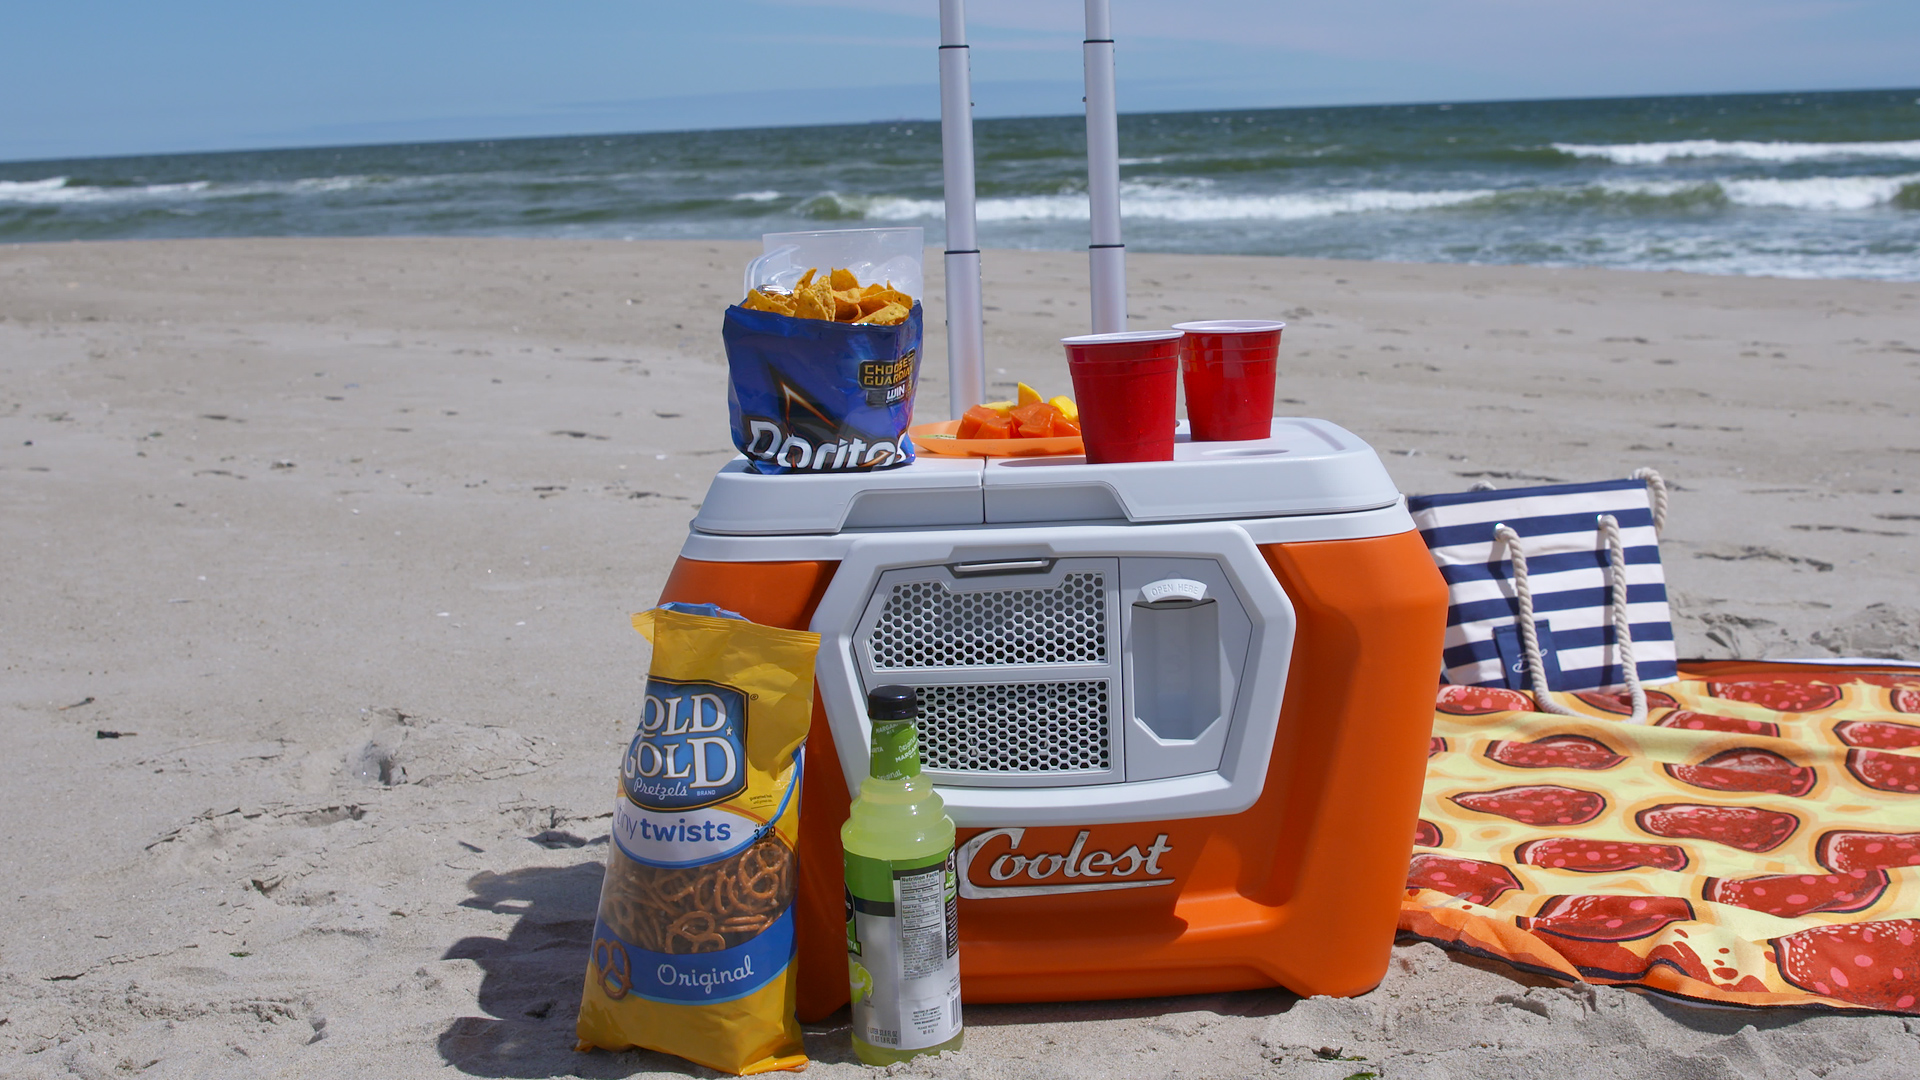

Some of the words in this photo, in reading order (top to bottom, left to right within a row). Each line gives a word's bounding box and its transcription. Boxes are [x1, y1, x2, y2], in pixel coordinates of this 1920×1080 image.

[864, 357, 908, 375] CHOOSE
[886, 384, 905, 400] WIN
[748, 420, 907, 470] Doritos
[1151, 584, 1174, 596] OPEN
[1178, 583, 1199, 594] HERE
[642, 693, 727, 736] OLD
[625, 729, 737, 788] GOLD
[634, 777, 688, 800] Pretzels
[640, 818, 731, 842] twists
[957, 827, 1176, 899] Coolest
[657, 955, 754, 994] Original
